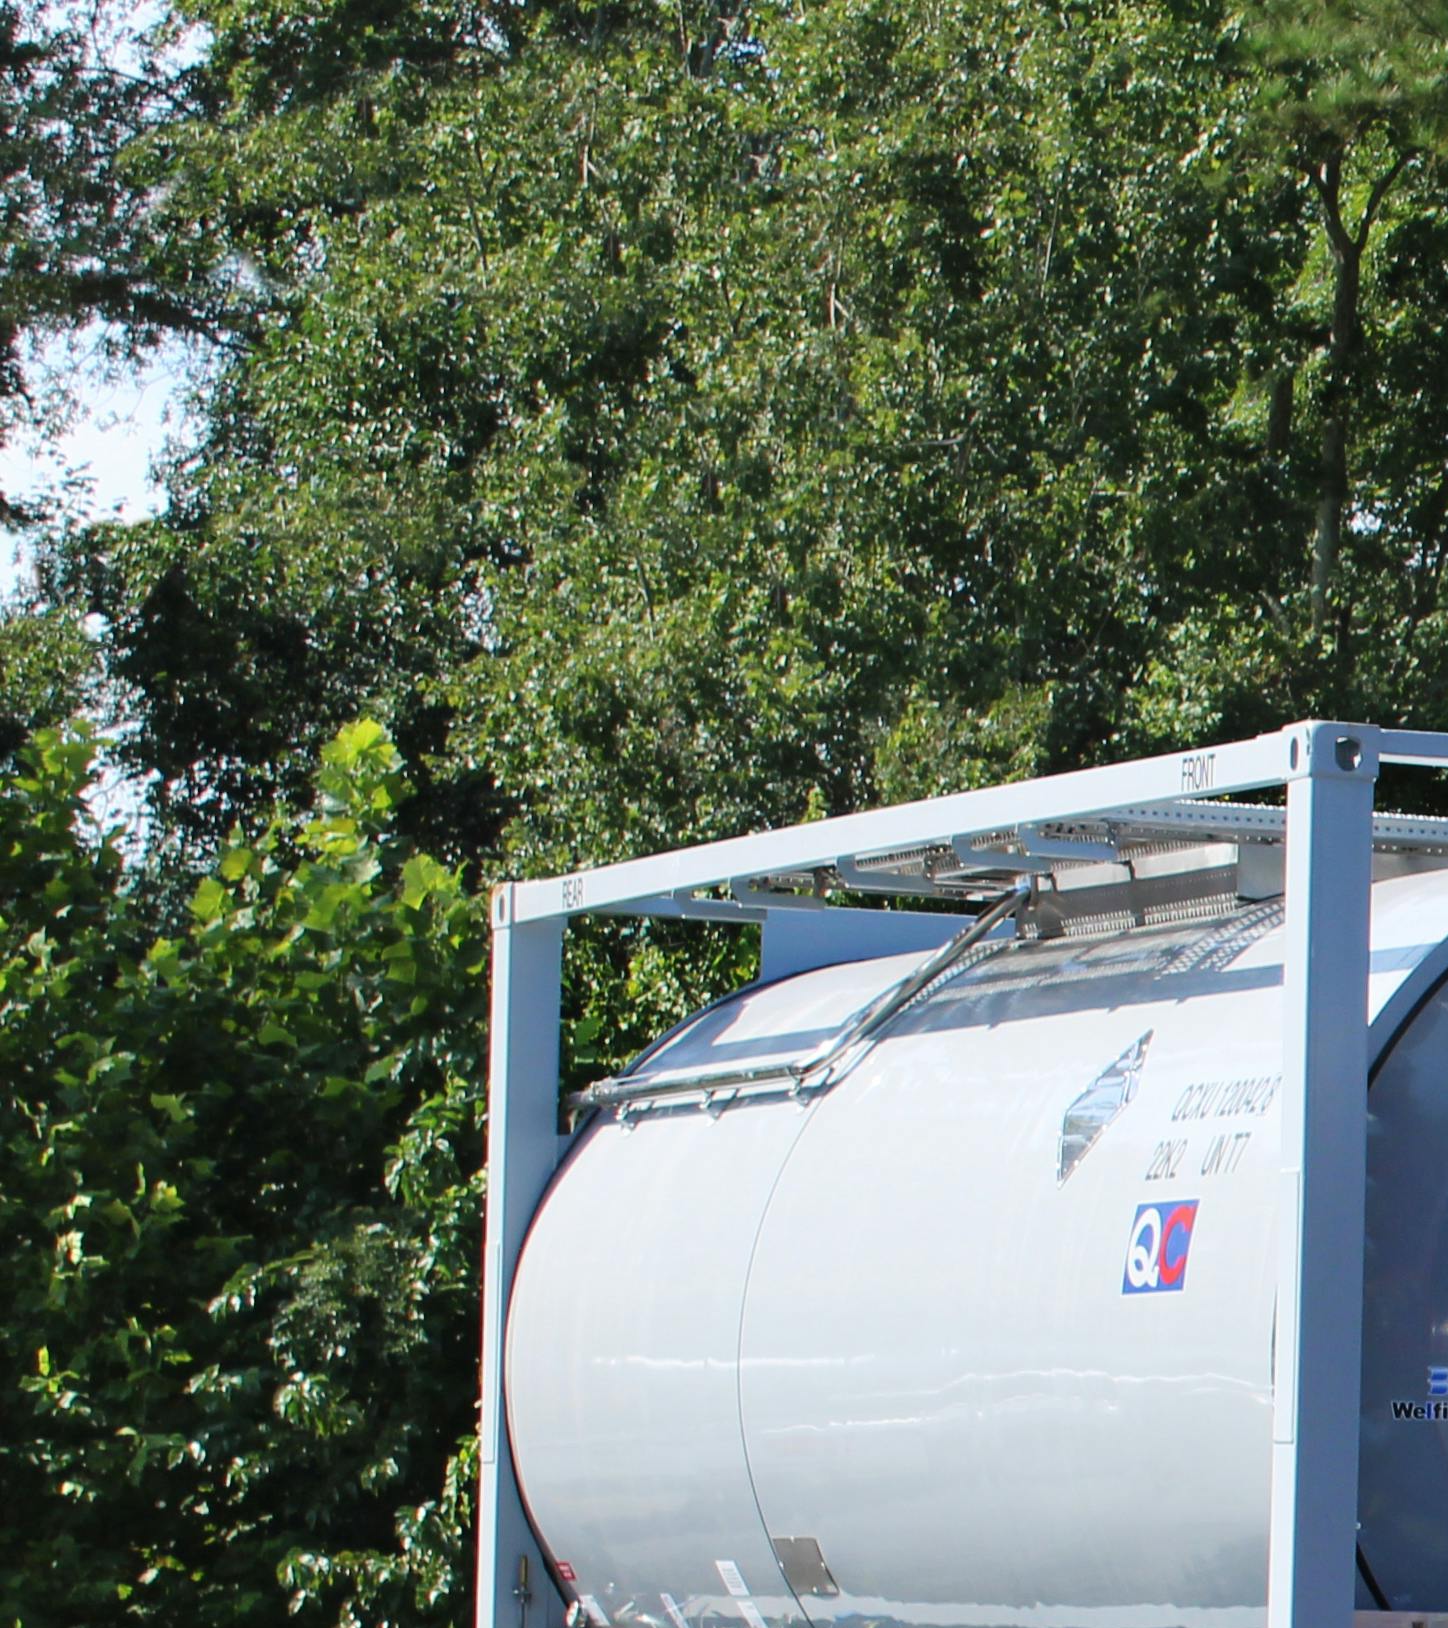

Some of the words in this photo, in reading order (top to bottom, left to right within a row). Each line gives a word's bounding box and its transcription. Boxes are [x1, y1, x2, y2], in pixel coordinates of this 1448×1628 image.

[1181, 753, 1216, 792] FRONT
[562, 878, 584, 909] REAR
[1126, 1205, 1198, 1288] QC
